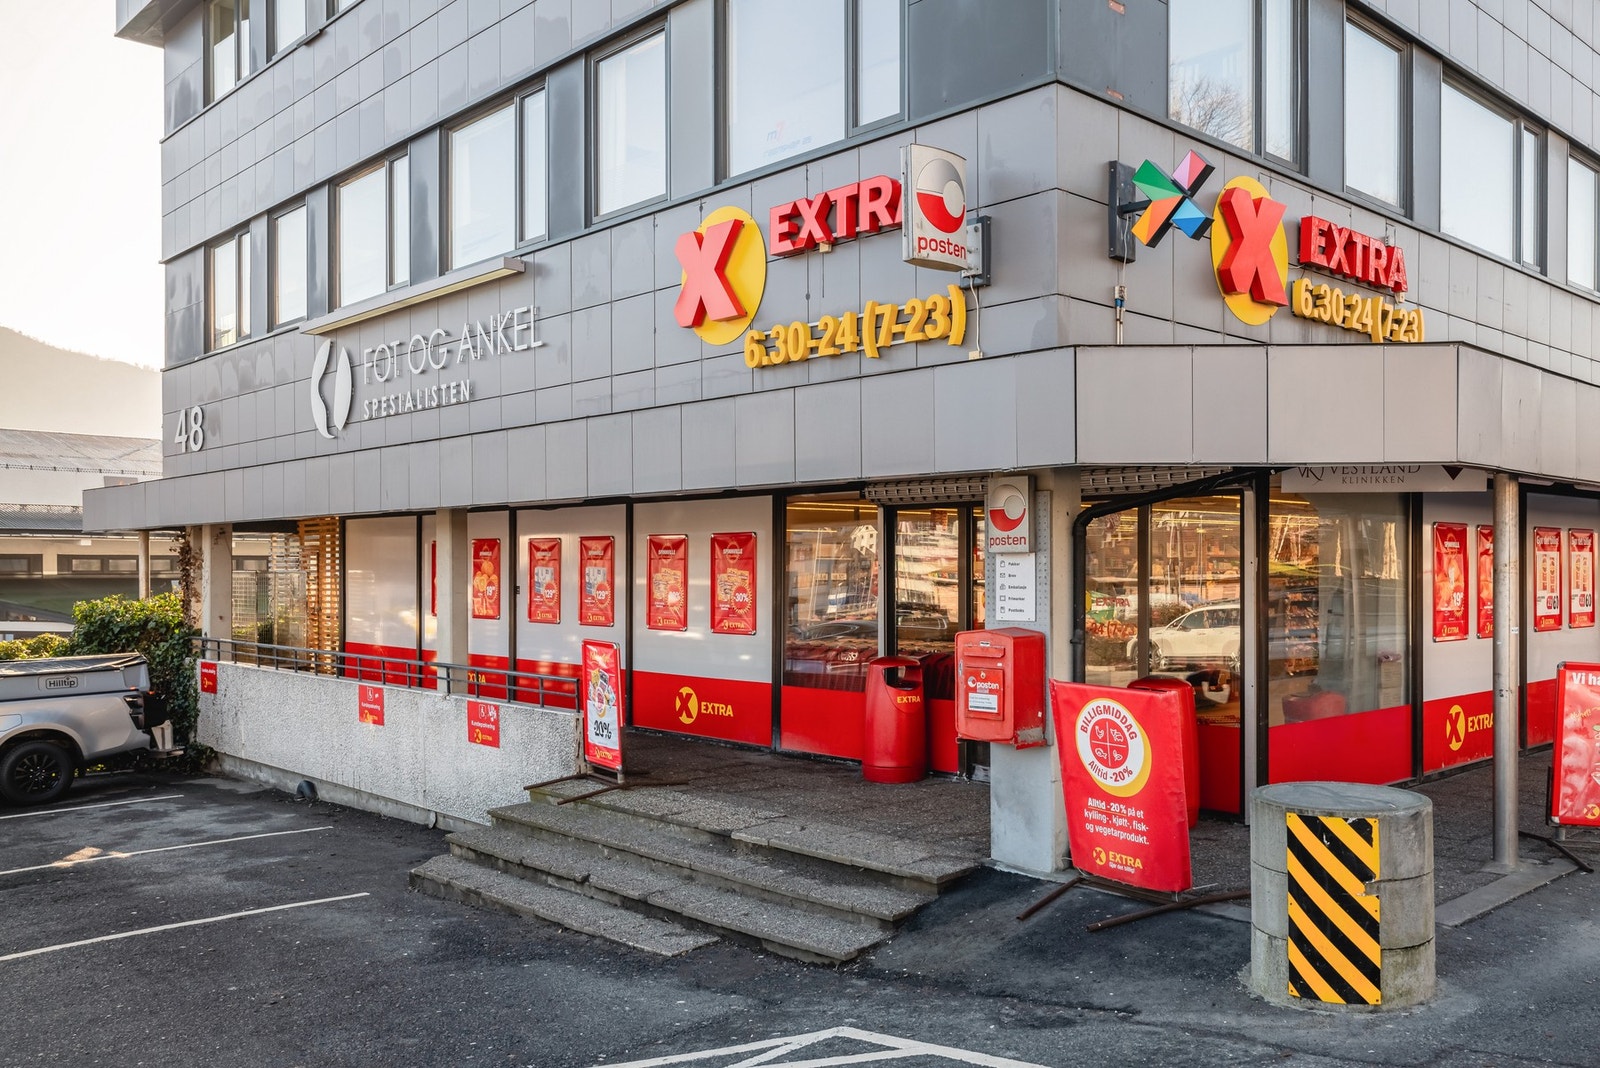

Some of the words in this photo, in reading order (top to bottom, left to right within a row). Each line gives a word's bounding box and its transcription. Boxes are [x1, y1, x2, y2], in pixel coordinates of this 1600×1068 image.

[770, 174, 902, 256] EXTR
[917, 234, 967, 260] posten
[1219, 187, 1289, 307] X
[1300, 215, 1409, 293] EXTRA
[674, 218, 749, 328] X
[1292, 277, 1374, 334] 6.30-24
[744, 311, 859, 368] 6.30-24
[862, 284, 966, 358] (7-23)
[363, 339, 401, 385] FOT
[407, 327, 449, 375] OG
[457, 304, 544, 364] ANKEL
[363, 379, 471, 420] SPESIALISTEN
[174, 405, 204, 454] 48
[1342, 476, 1405, 484] KLINIKKEN
[989, 534, 1027, 548] posten
[48, 679, 76, 688] Hilltip
[976, 681, 1000, 690] posten
[1572, 672, 1585, 684] Vi
[701, 701, 734, 717] EXTRA
[897, 695, 921, 704] EXTRA
[1080, 704, 1138, 740] BILLIGMIDDAG
[1088, 760, 1108, 780] Alltid
[1110, 765, 1134, 782] -20%
[1087, 797, 1106, 810] Alltid
[1127, 806, 1136, 817] på
[1136, 809, 1144, 819] et
[1085, 822, 1094, 833] og
[1095, 824, 1150, 845] vegetarprodukt.
[1132, 820, 1149, 832] fisk-
[1108, 851, 1143, 869] EXTRA
